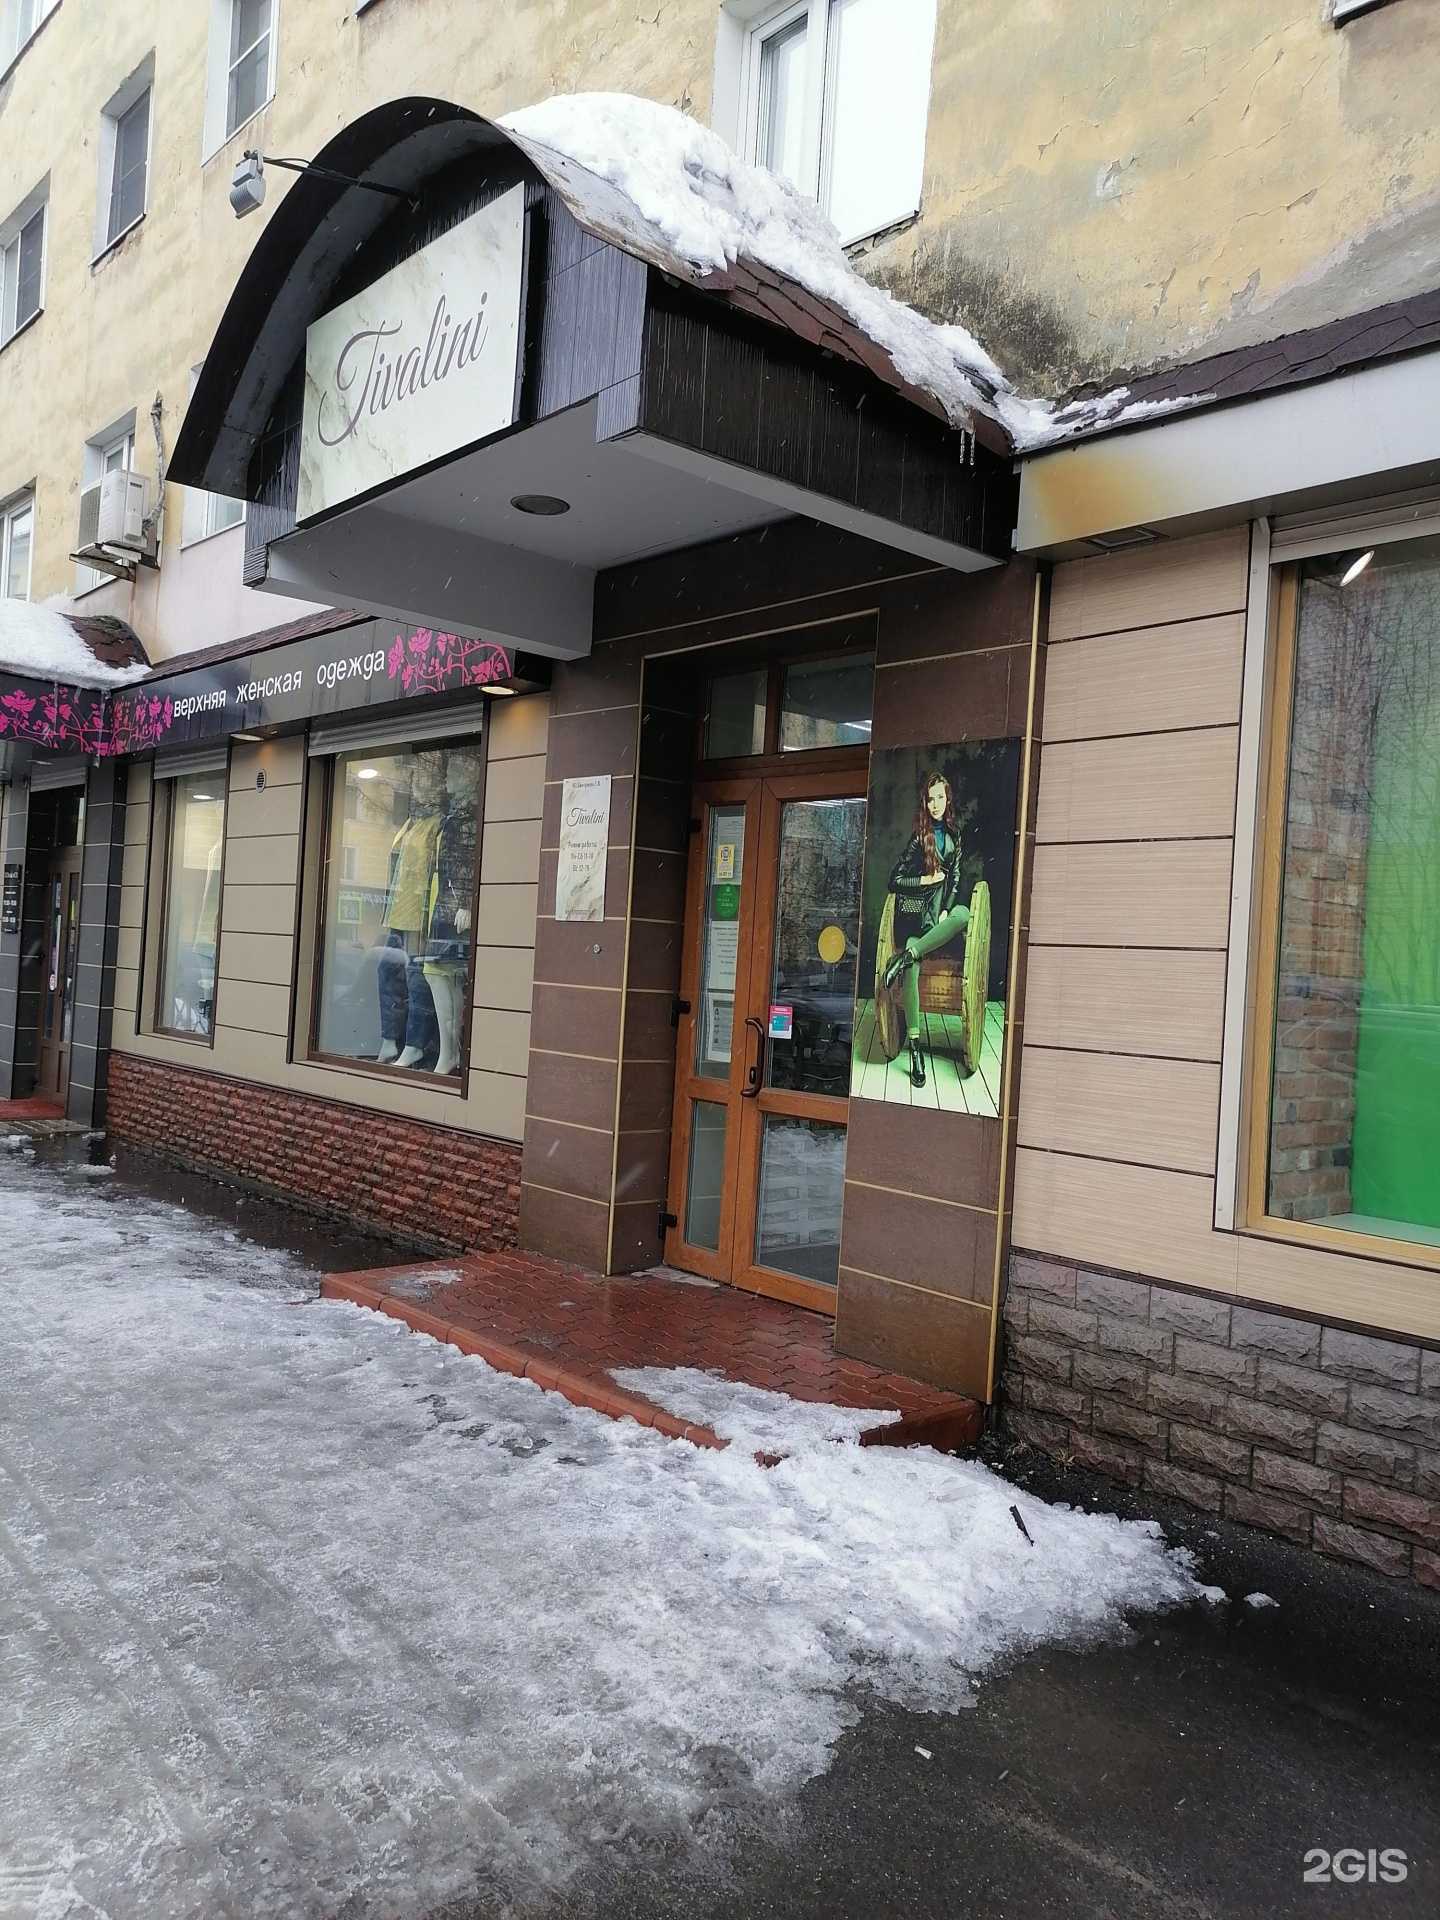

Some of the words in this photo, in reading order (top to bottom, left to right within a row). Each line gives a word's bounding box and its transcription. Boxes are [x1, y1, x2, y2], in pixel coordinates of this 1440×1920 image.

[318, 292, 488, 446] Tivalini
[173, 689, 227, 720] верхняя
[236, 670, 302, 704] женская
[316, 649, 385, 688] одежда
